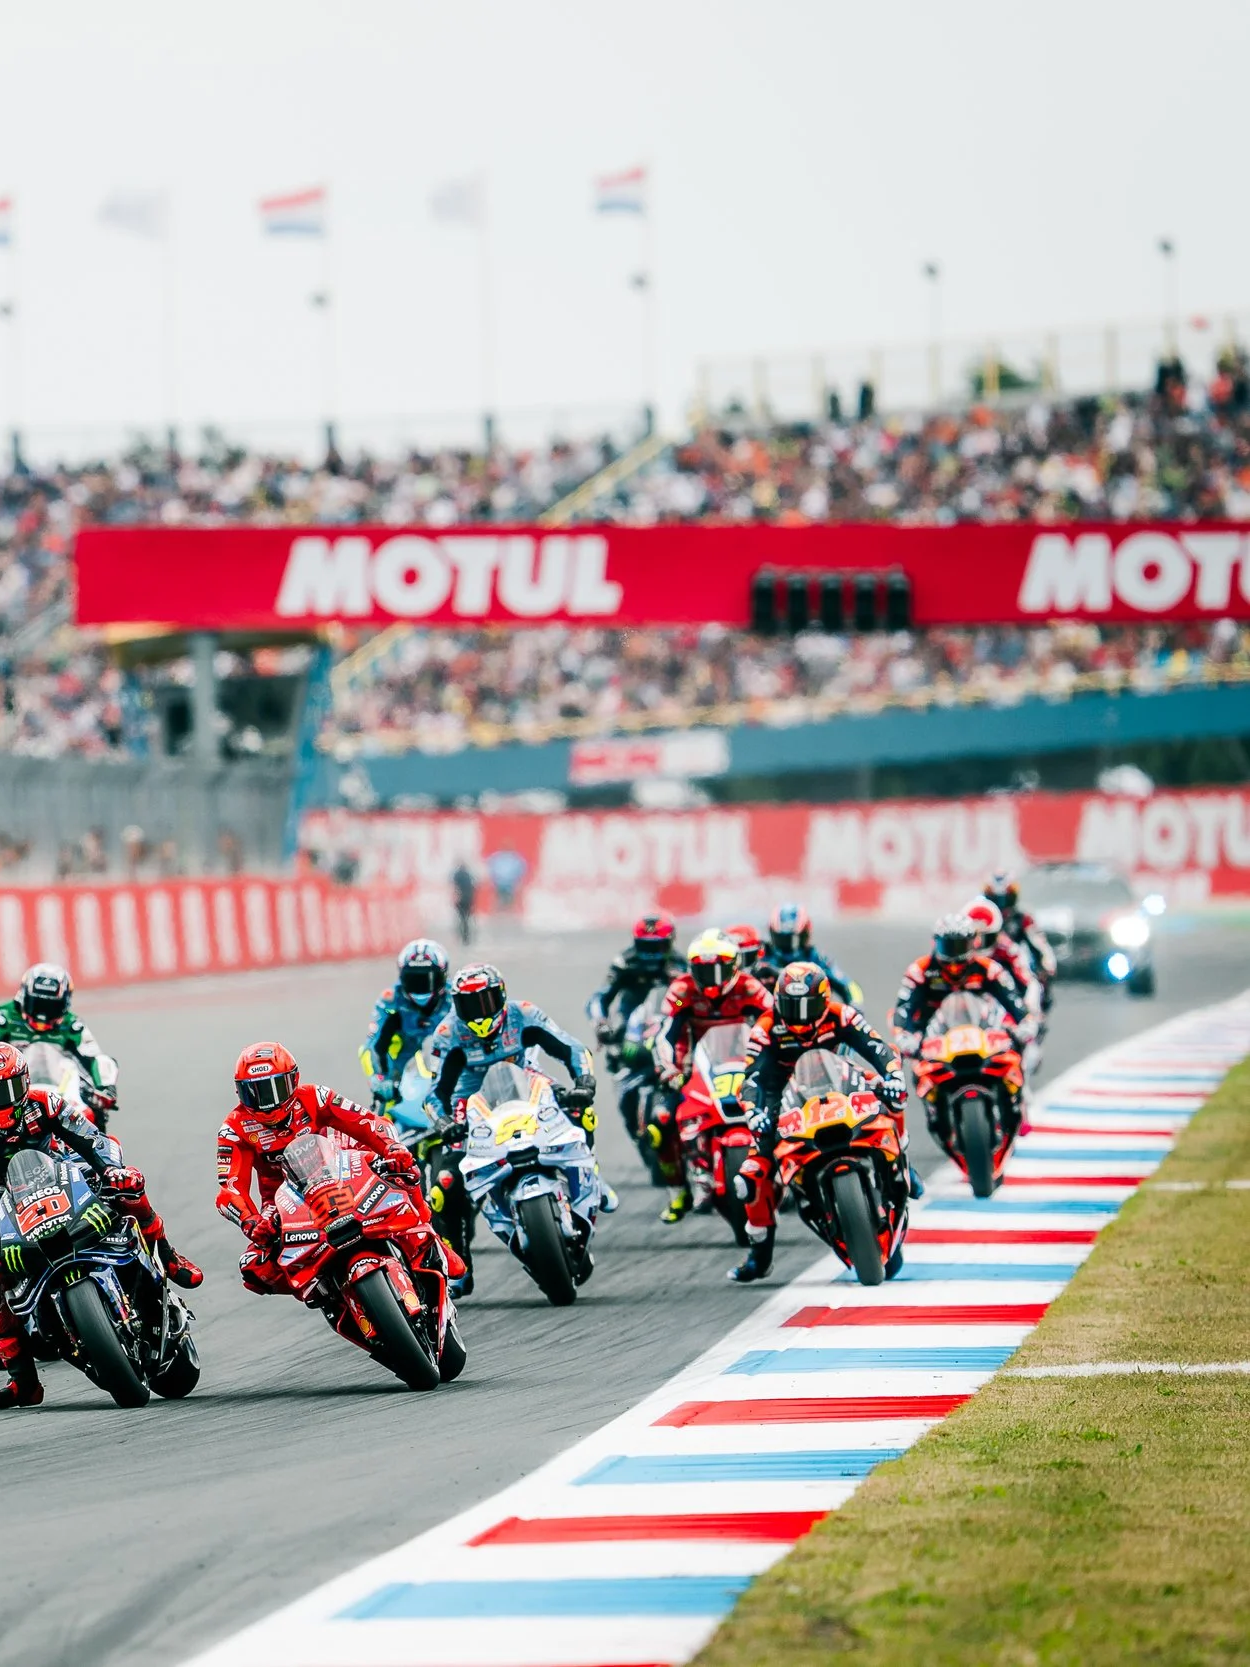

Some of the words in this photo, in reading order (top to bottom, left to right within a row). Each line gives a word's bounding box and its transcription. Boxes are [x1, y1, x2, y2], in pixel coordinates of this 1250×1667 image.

[275, 534, 623, 617] MOTUL
[1017, 530, 1250, 613] MOT
[536, 814, 761, 880] MOTUL
[805, 804, 1029, 879] MOTUL
[251, 1065, 269, 1073] SHOEI
[808, 1096, 846, 1126] 12
[495, 1114, 540, 1145] 54
[22, 1186, 61, 1207] ENEOS
[356, 1184, 385, 1214] Lenovo
[15, 1188, 71, 1236] 20
[25, 1214, 73, 1241] MONSTER
[285, 1232, 318, 1242] Lenovo
[292, 1248, 305, 1260] TIM
[349, 1258, 378, 1281] Lenovo
